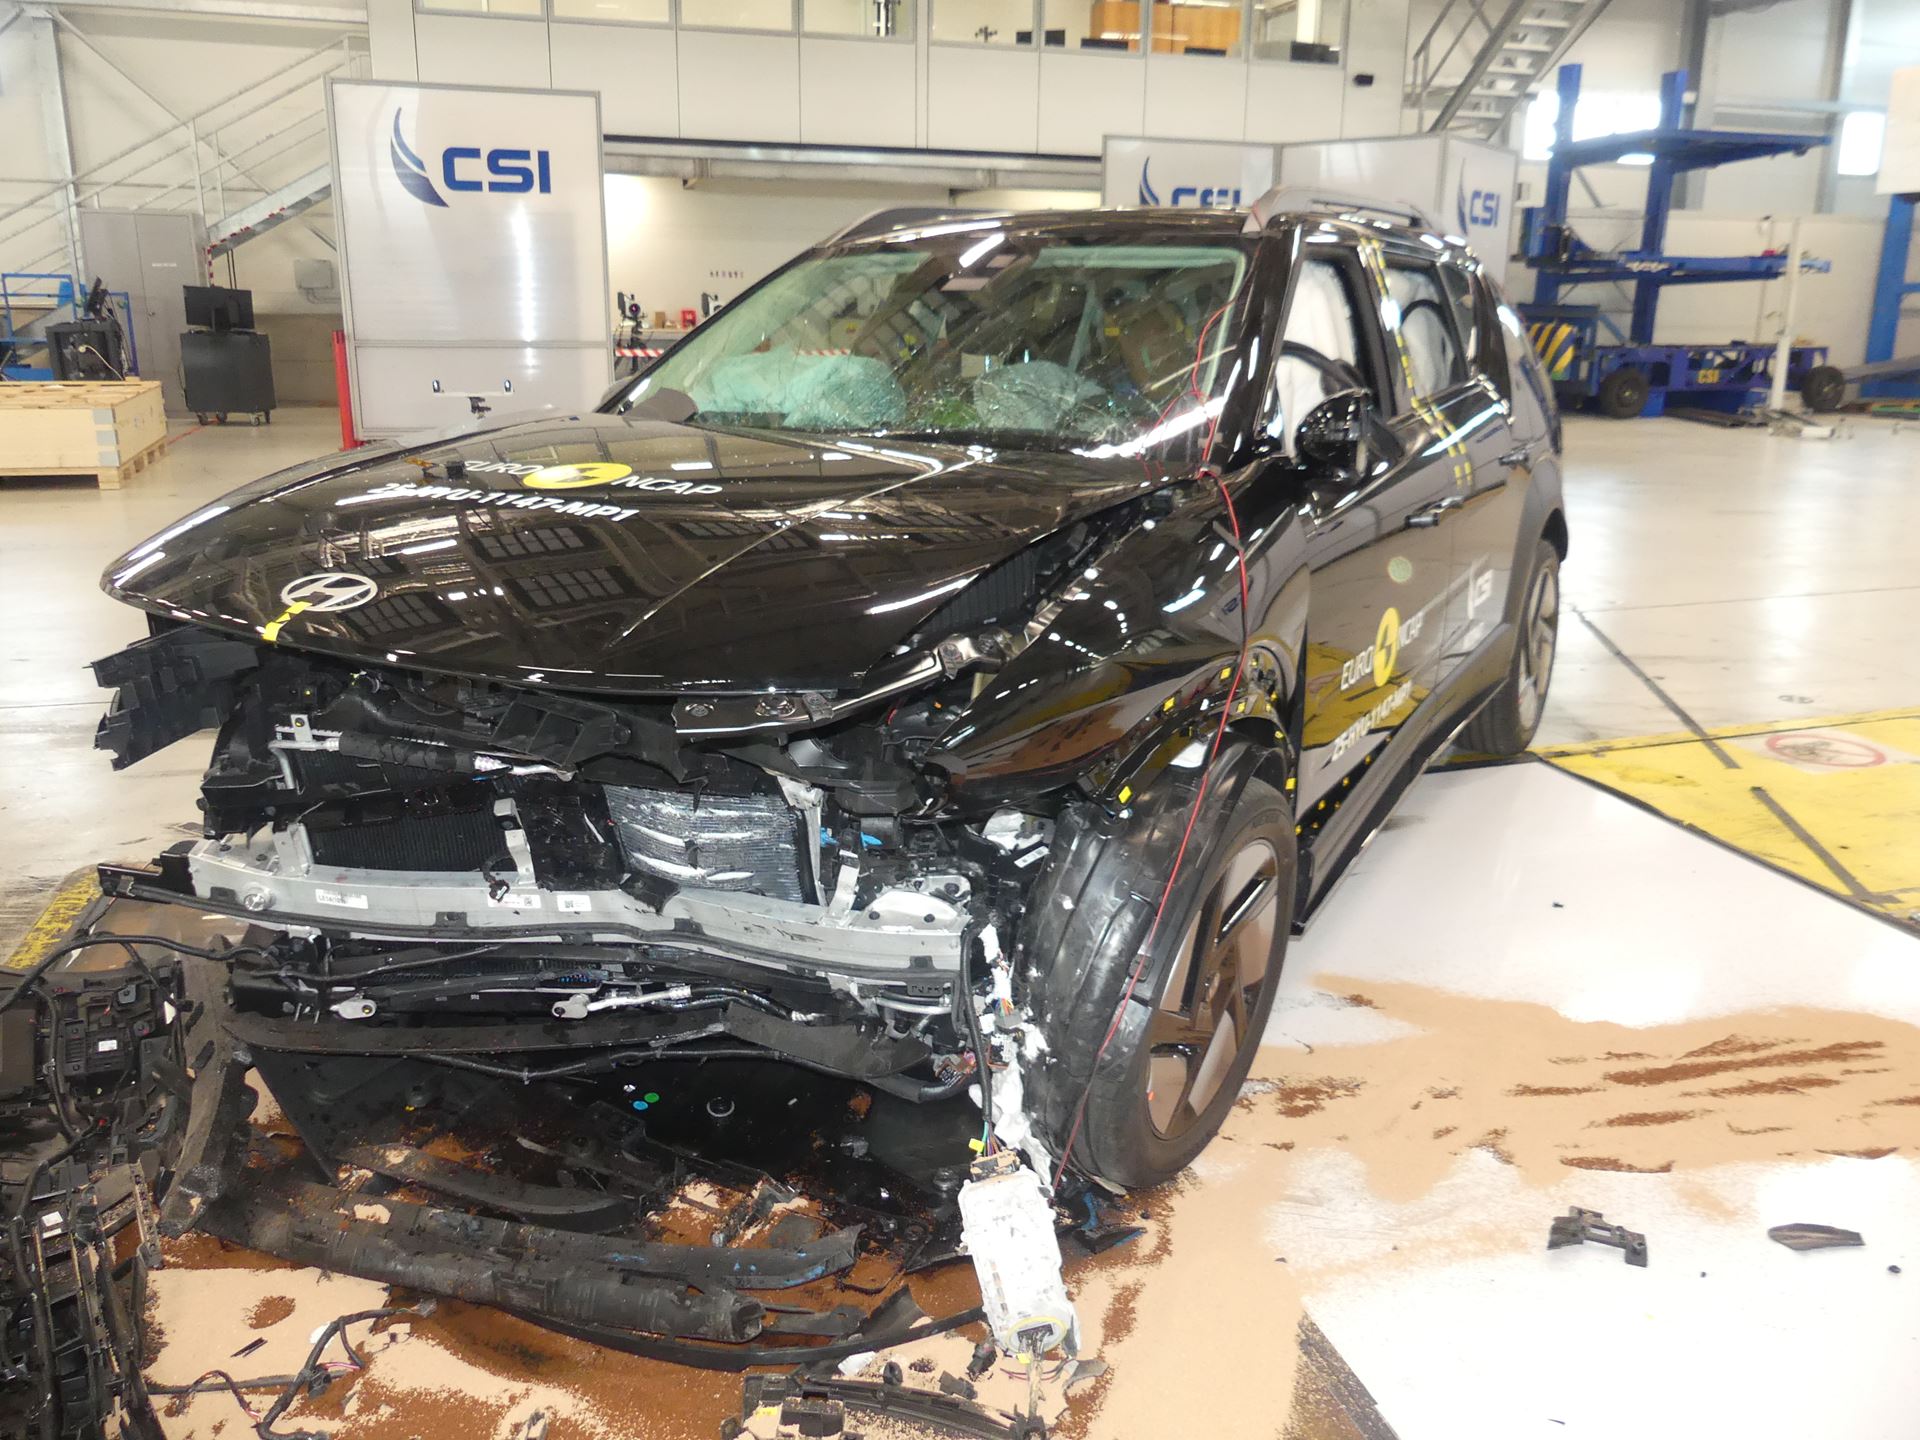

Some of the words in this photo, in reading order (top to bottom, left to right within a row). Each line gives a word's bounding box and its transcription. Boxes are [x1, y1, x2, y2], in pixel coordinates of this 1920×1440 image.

[442, 147, 551, 193] CSI
[1470, 190, 1500, 228] CSI
[464, 460, 544, 475] EURO
[610, 475, 723, 495] NCAP
[1340, 645, 1376, 691] EURO
